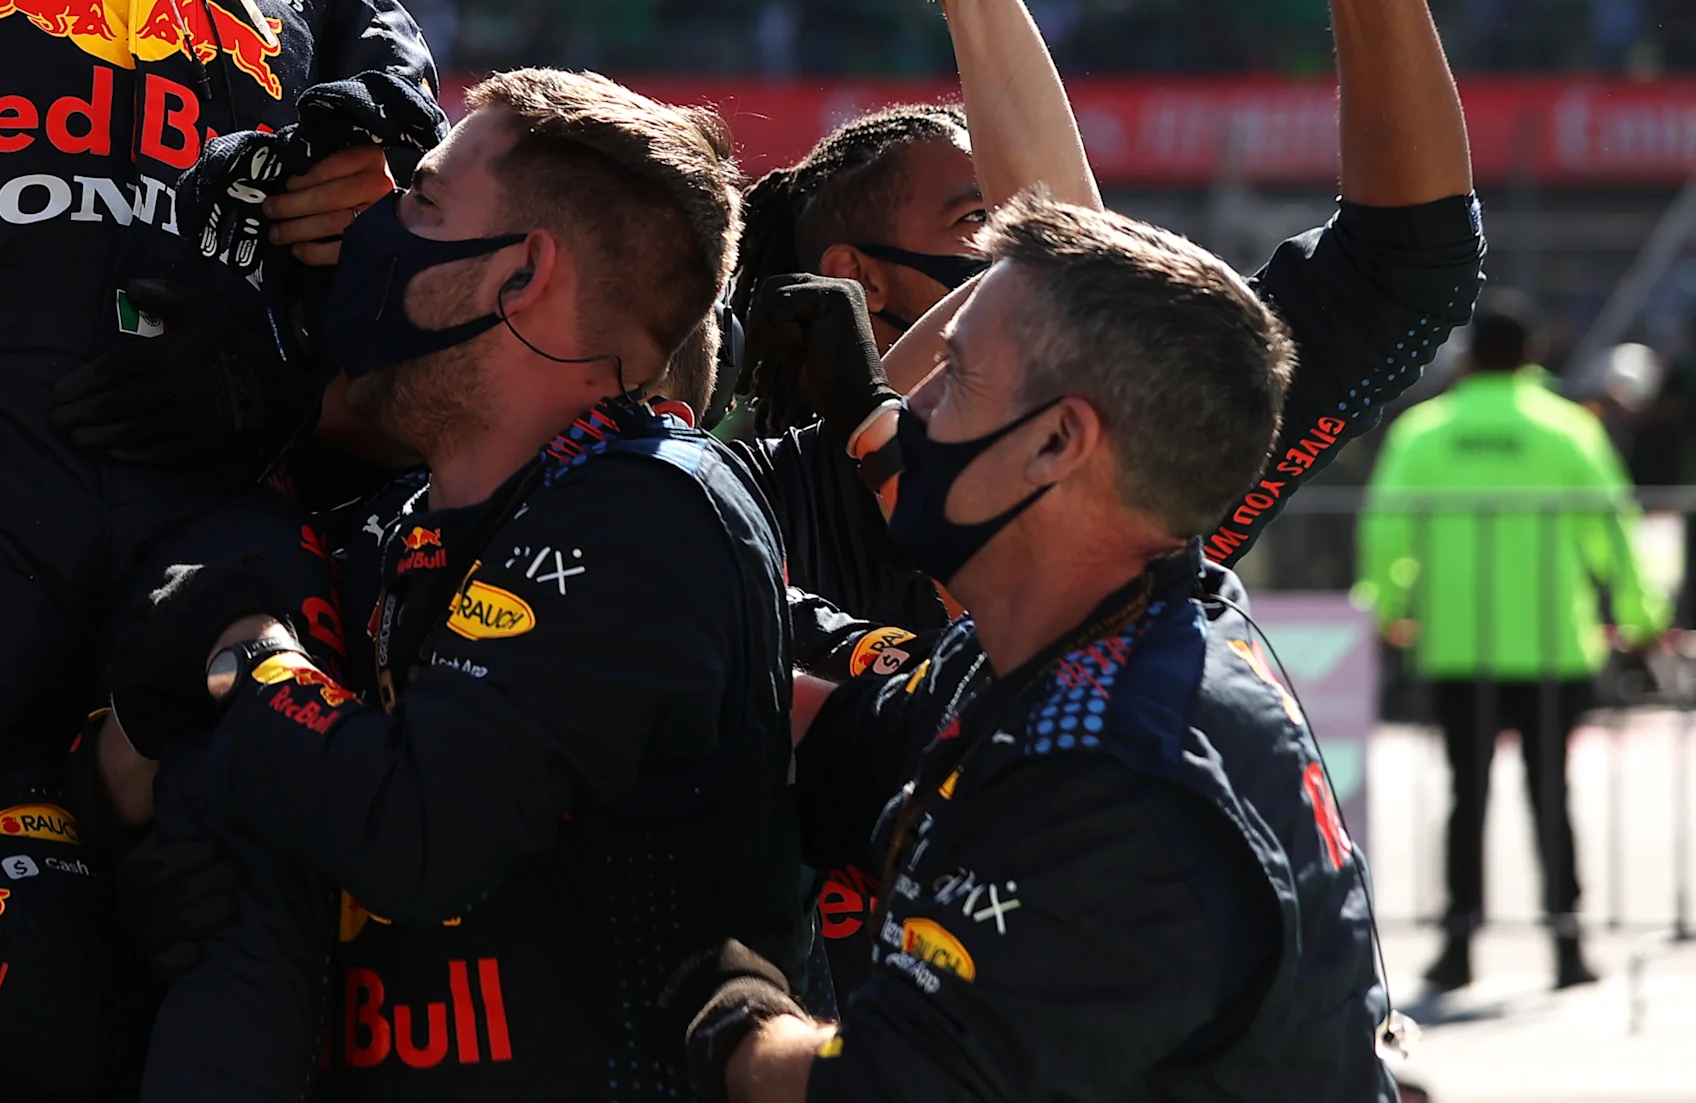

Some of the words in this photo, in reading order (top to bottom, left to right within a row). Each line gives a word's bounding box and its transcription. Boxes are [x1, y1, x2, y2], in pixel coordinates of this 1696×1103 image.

[1275, 415, 1347, 478] GIVES
[1232, 479, 1288, 526] YOU
[21, 814, 78, 840] RAUC
[44, 856, 91, 877] Cash
[344, 955, 514, 1070] Bull
